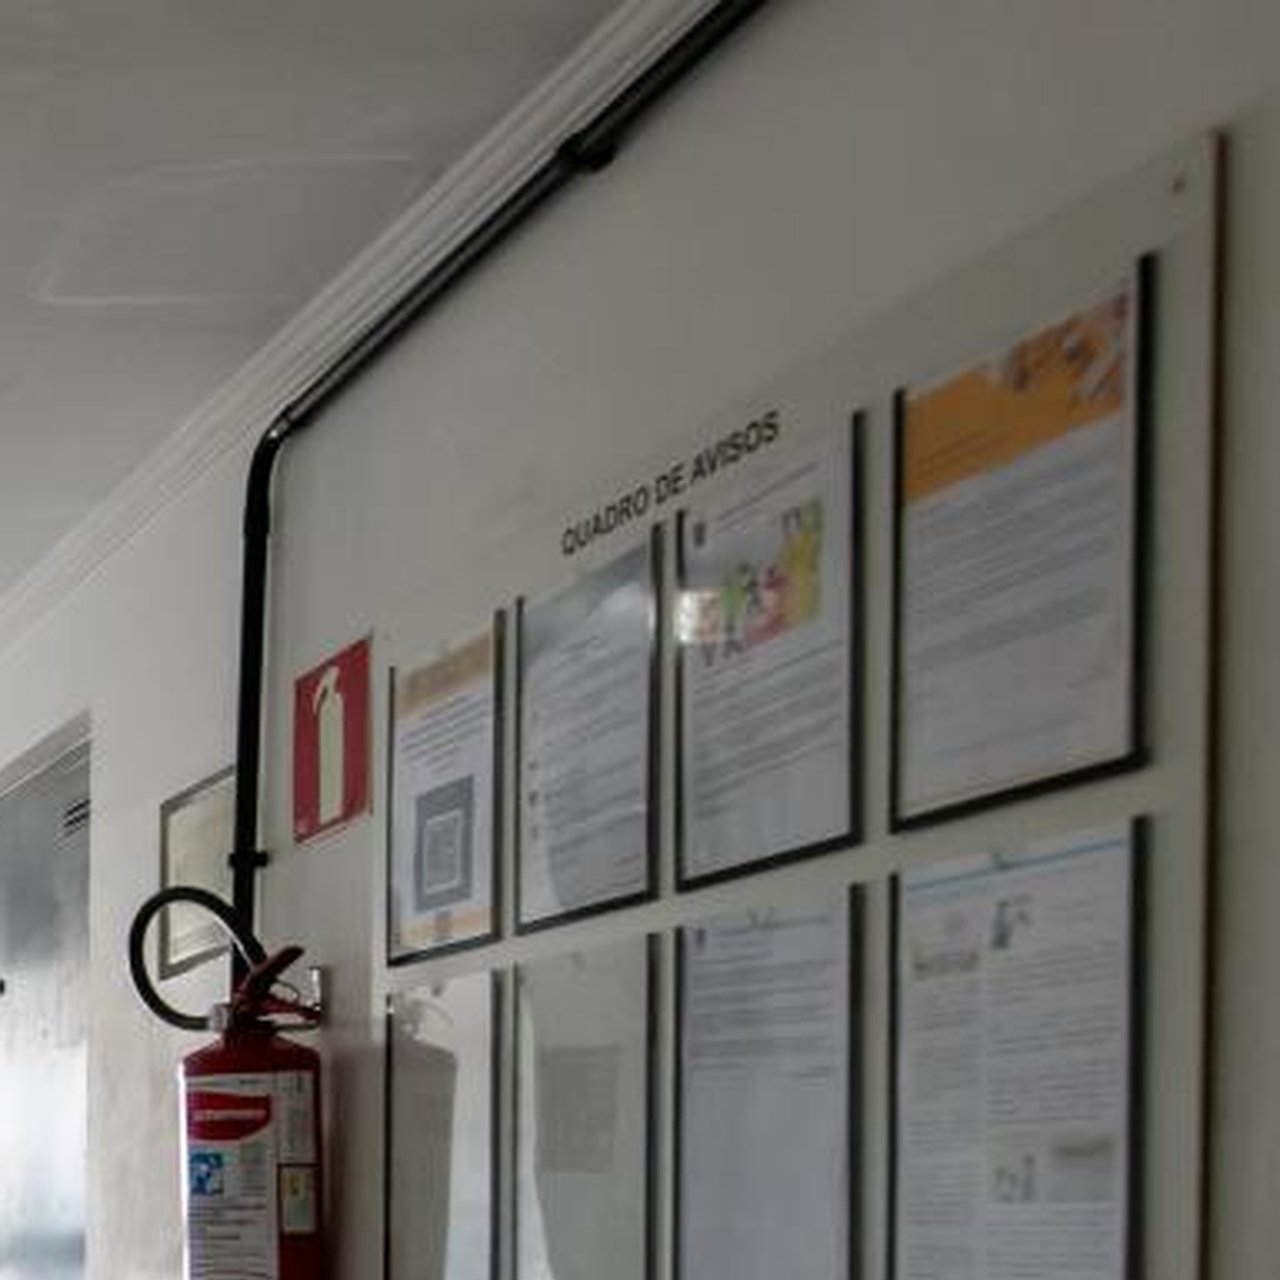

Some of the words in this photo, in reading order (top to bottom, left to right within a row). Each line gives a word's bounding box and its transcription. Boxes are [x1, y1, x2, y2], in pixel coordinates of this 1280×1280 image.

[560, 484, 649, 555] QUADRO
[654, 462, 687, 504] DE
[690, 409, 779, 484] AVISOS
